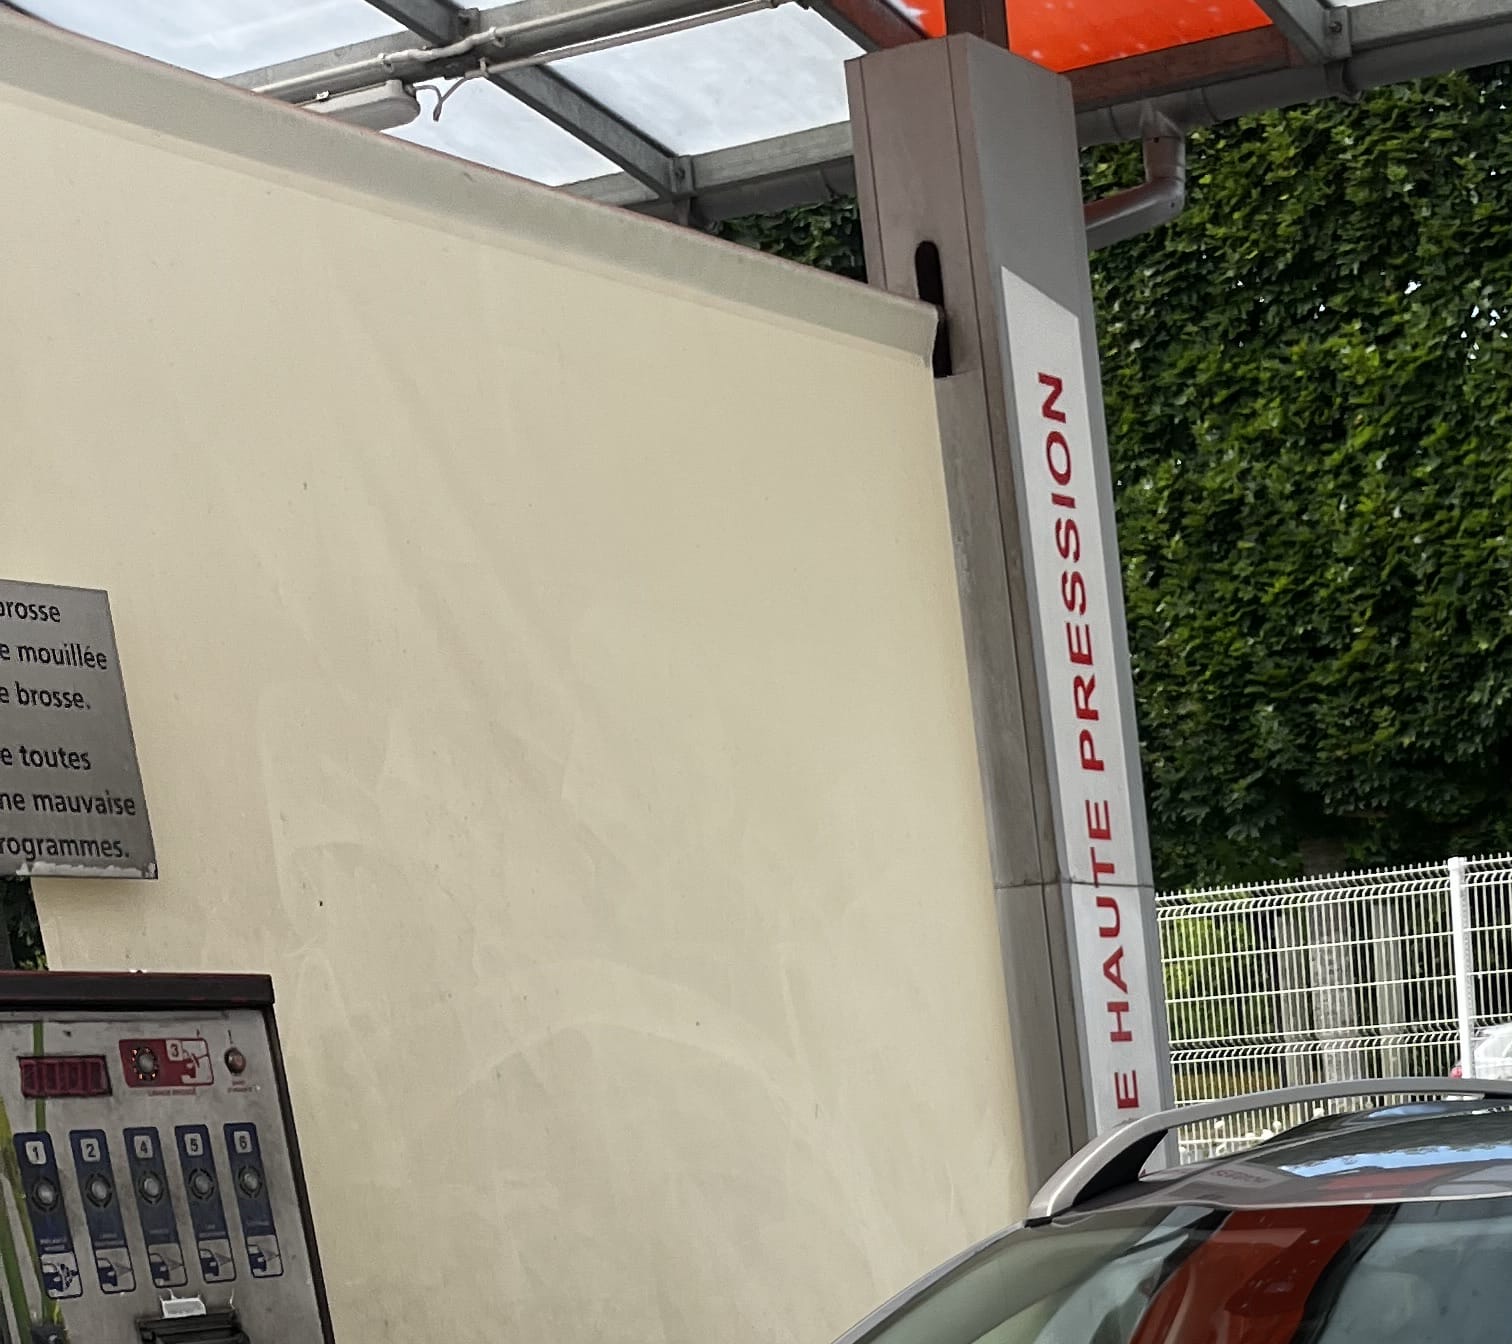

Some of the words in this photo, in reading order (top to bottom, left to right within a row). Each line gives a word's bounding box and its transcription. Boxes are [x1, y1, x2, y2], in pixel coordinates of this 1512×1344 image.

[1038, 371, 1104, 771] PRESSION
[17, 643, 107, 670] mouillée
[15, 681, 91, 710] brosse.
[19, 745, 91, 770] toutes
[33, 791, 136, 816] mauvaise
[1086, 799, 1133, 1042] HAUTE
[169, 1043, 179, 1058] 3
[86, 1143, 96, 1158] 2
[140, 1140, 148, 1154] 4
[190, 1138, 198, 1152] 5
[239, 1135, 247, 1150] 6
[33, 1146, 39, 1160] 1
